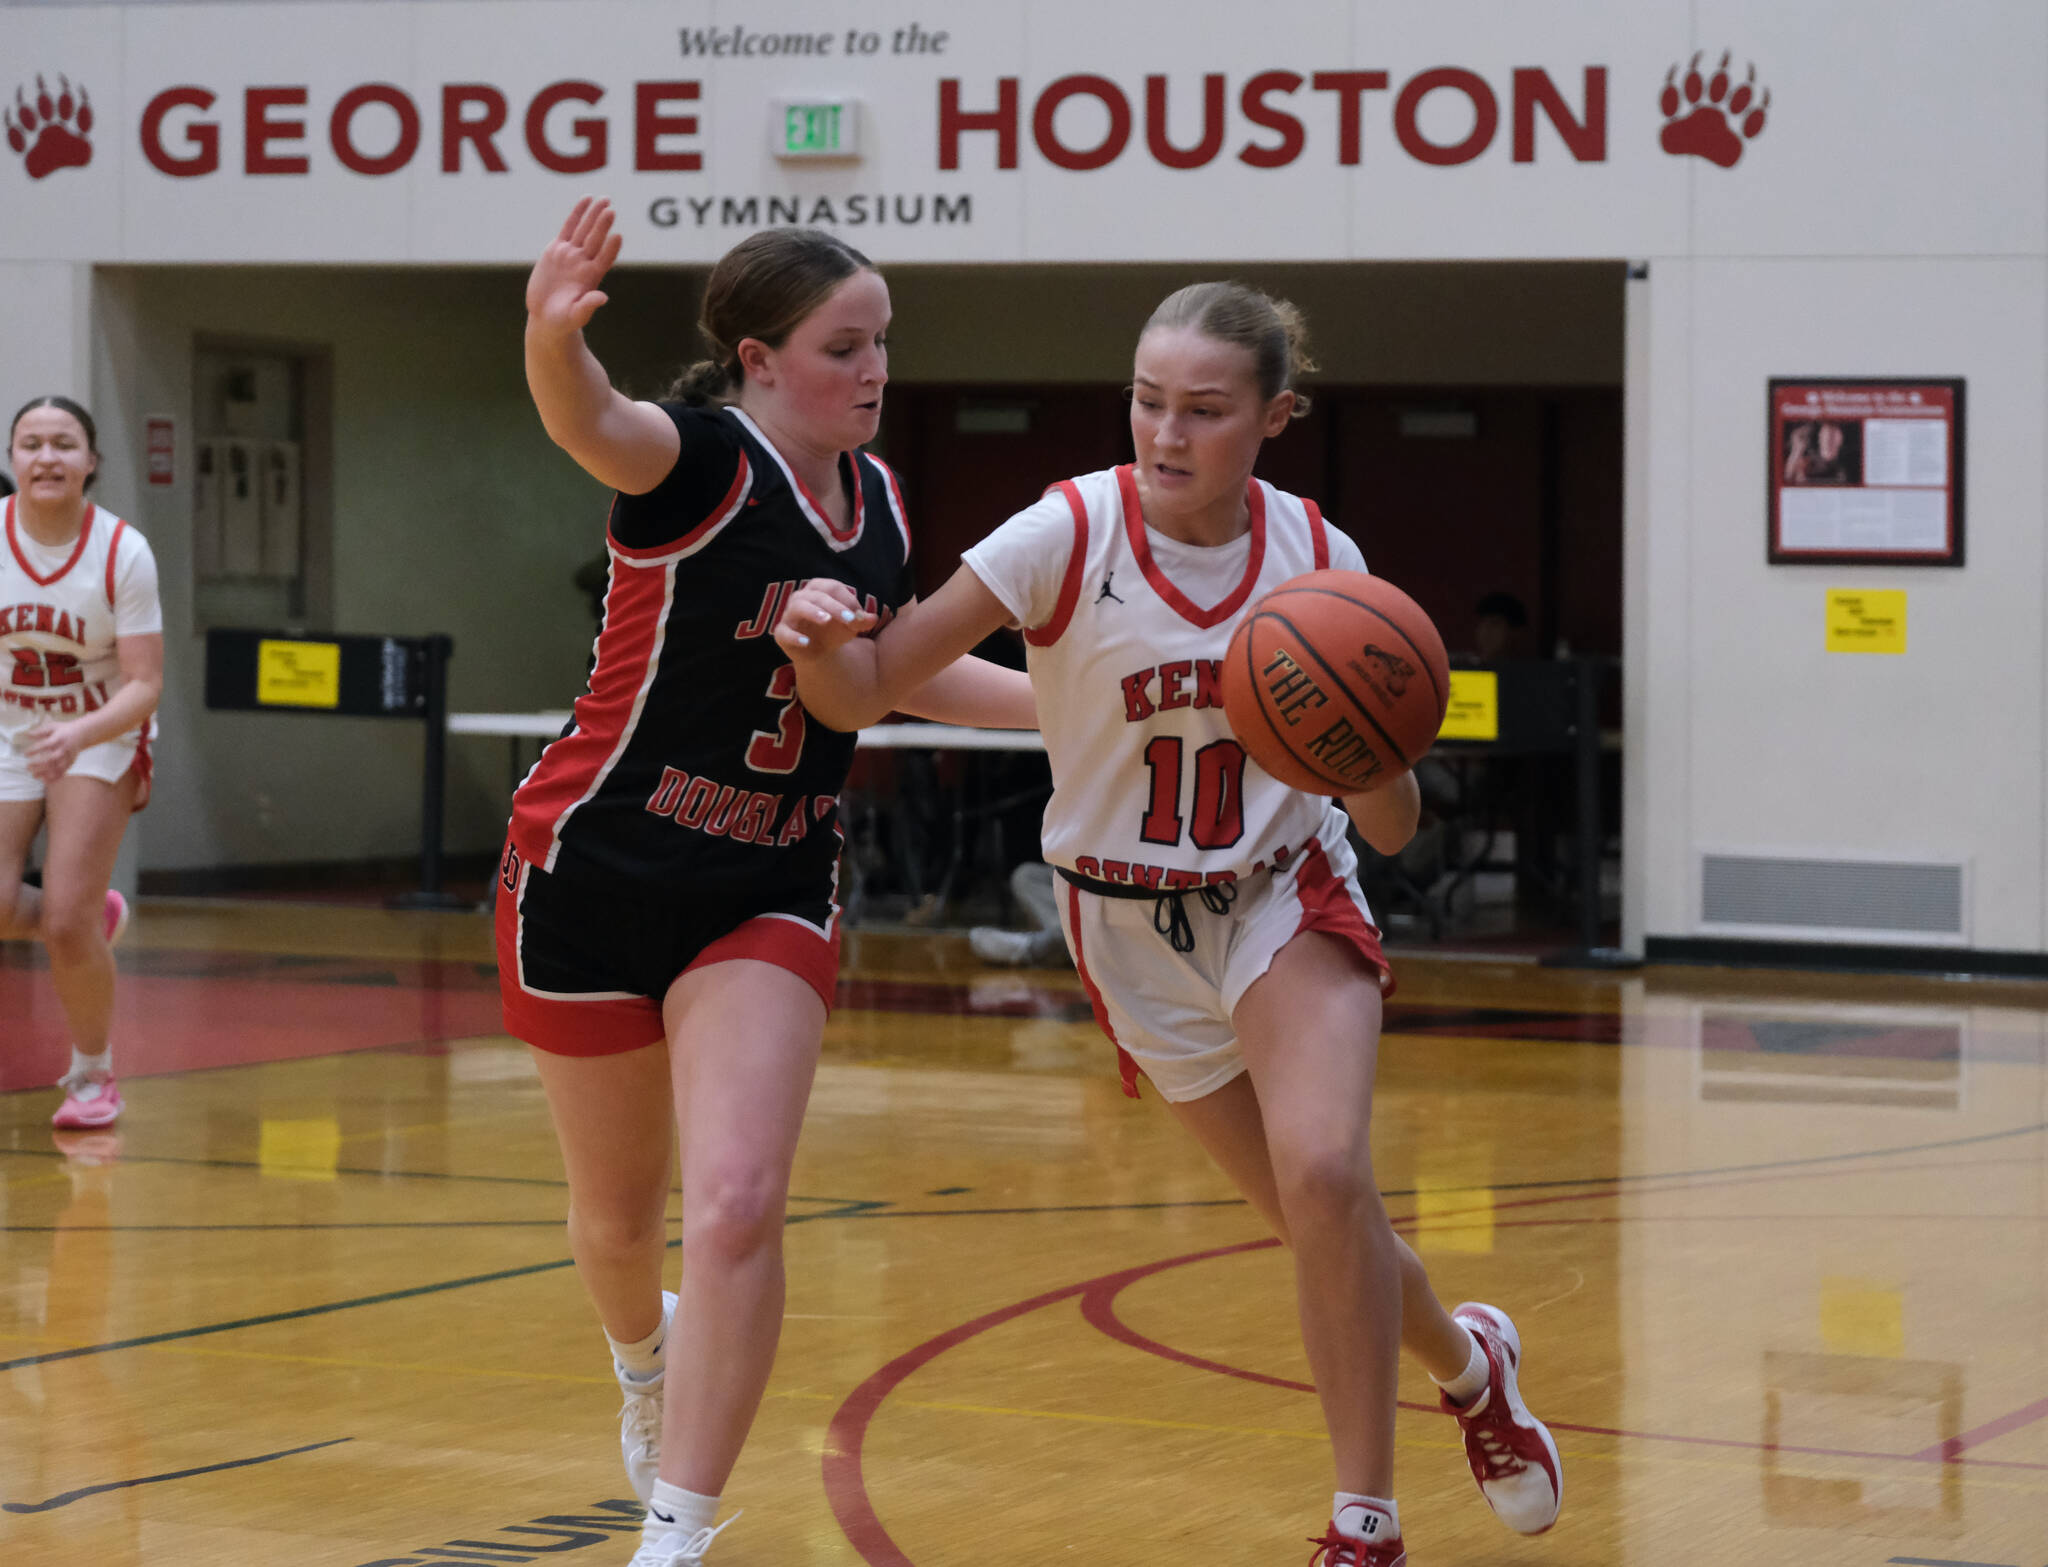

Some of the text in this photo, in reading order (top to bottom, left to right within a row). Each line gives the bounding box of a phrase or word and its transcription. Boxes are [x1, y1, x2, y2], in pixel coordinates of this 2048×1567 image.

[679, 22, 949, 57] Welcome to the
[140, 65, 1608, 179] GEORGE HOUSTON
[785, 104, 843, 153] EXIT
[649, 194, 973, 229] GYMNASIUM
[744, 662, 806, 775] 3
[1120, 659, 1224, 723] KEN
[1263, 647, 1330, 727] THE
[1304, 715, 1386, 785] ROCK
[1139, 735, 1248, 851] 10
